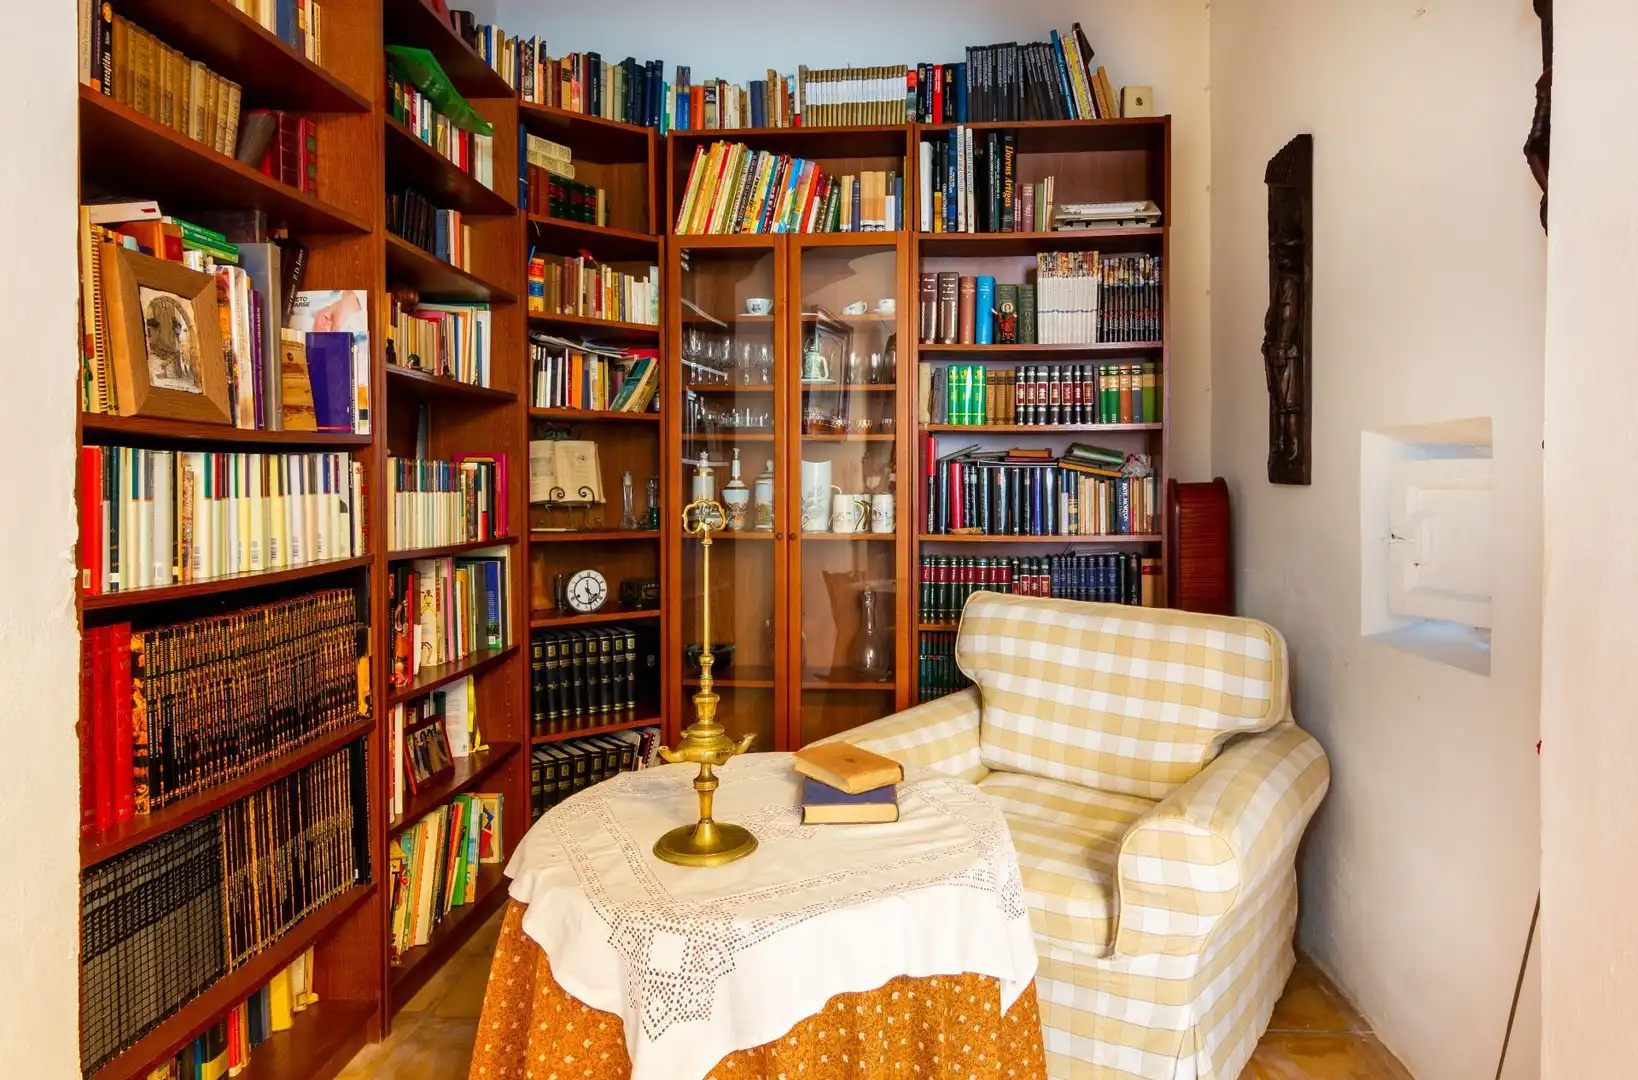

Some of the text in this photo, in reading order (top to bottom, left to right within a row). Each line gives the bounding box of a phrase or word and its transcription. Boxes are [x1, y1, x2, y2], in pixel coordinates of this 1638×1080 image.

[102, 52, 112, 86] escogidos
[1003, 145, 1014, 208] Llorens Artigas
